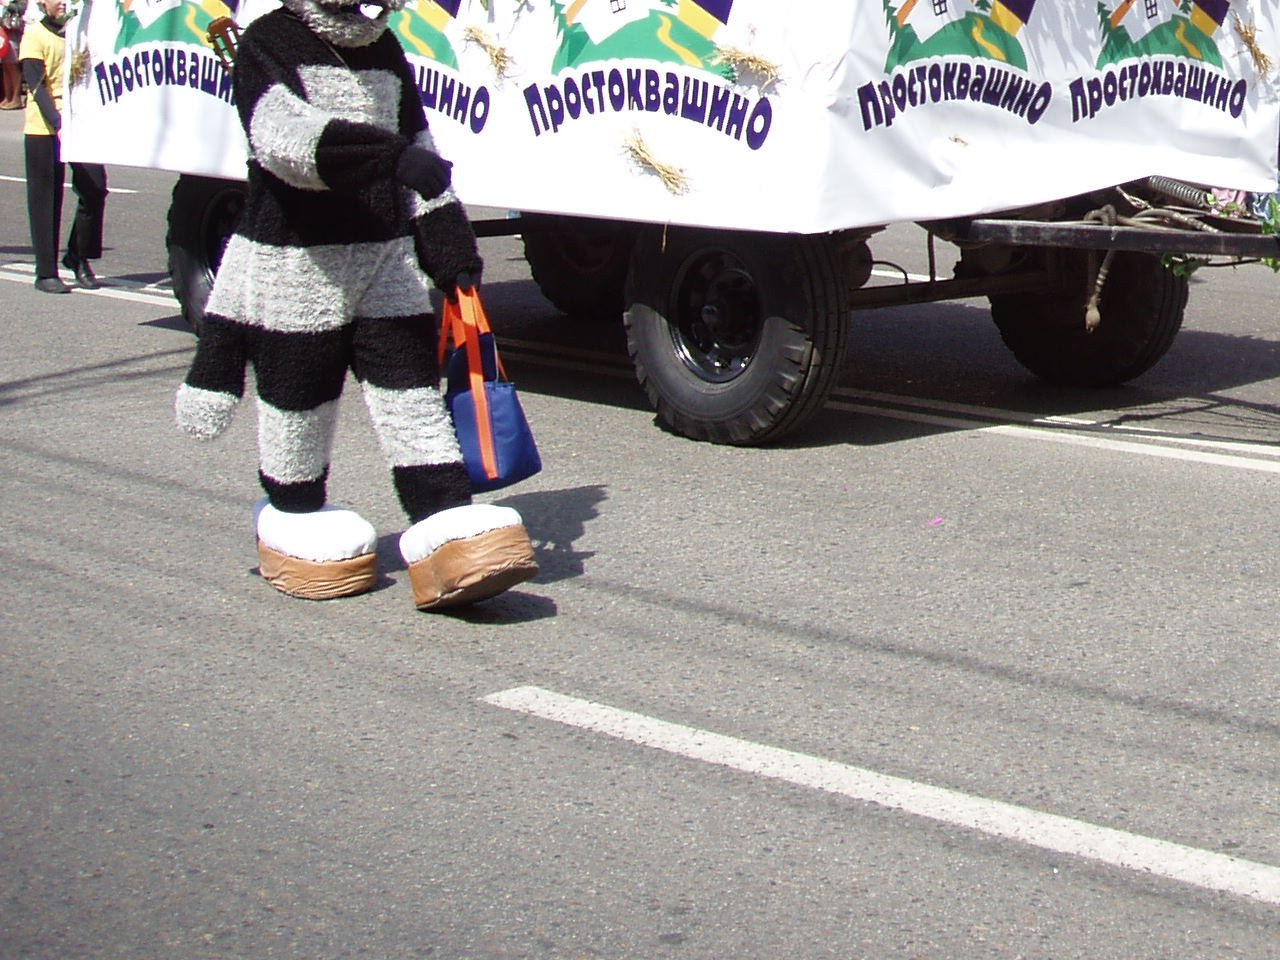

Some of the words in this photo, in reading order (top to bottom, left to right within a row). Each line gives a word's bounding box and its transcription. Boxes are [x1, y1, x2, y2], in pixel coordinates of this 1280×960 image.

[94, 48, 236, 106] Простокваши
[523, 68, 773, 151] Простоквашино
[857, 61, 1053, 131] Простоквашино
[1069, 59, 1247, 122] Простоквашино
